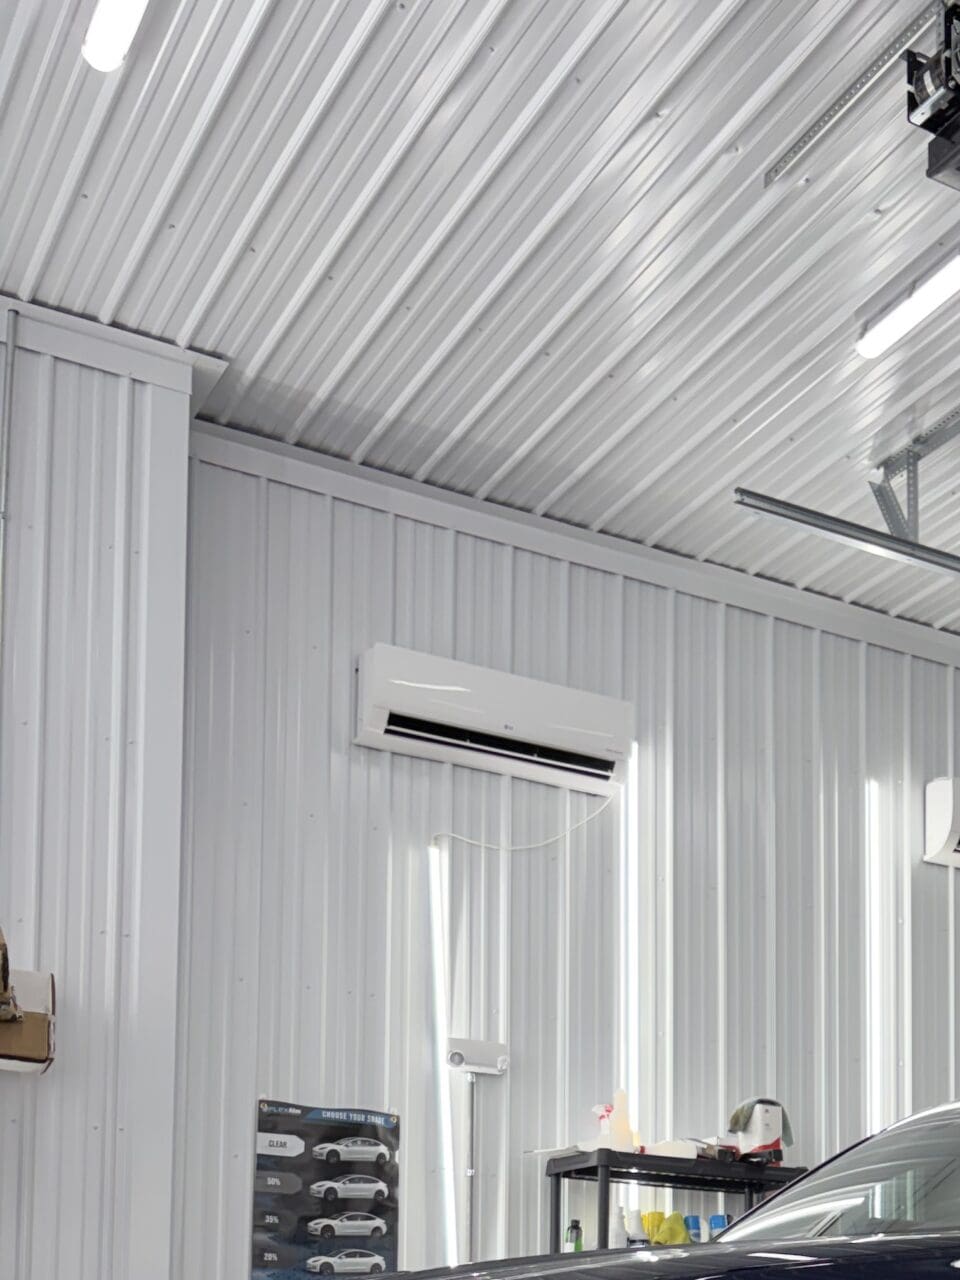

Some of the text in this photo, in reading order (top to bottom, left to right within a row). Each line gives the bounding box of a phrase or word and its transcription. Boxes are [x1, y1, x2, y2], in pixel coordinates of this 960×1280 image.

[322, 1110, 347, 1120] CHOOSE
[349, 1113, 365, 1122] YOUR
[268, 1139, 288, 1149] CLEAR
[265, 1214, 279, 1224] 35%
[263, 1252, 278, 1261] 20%
